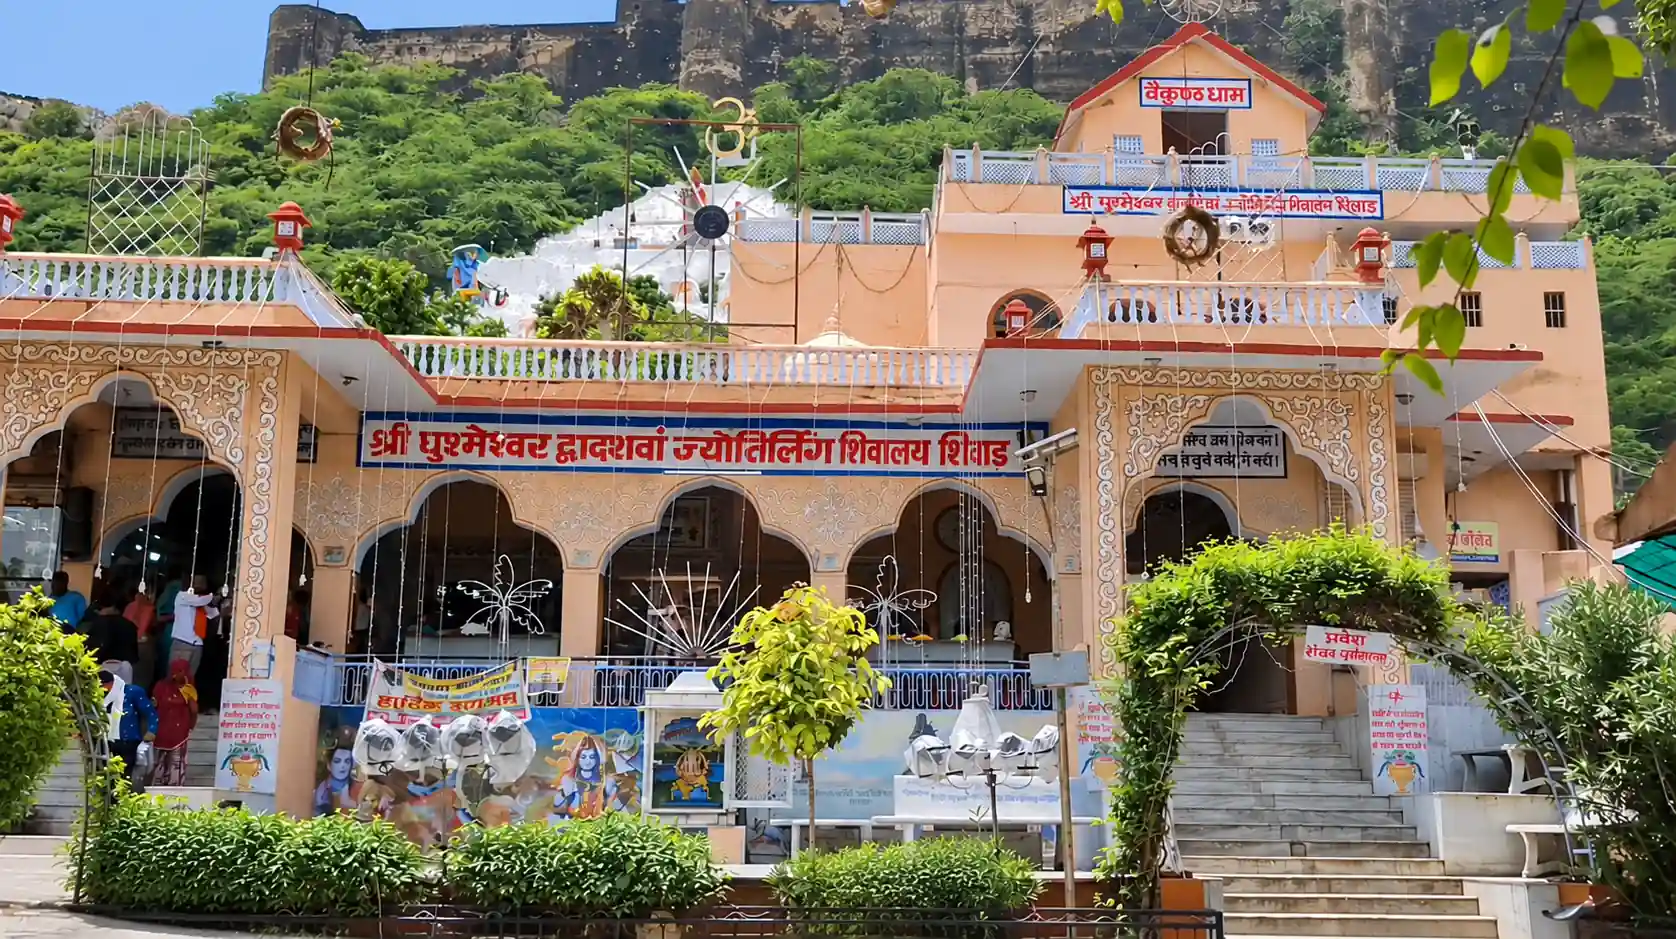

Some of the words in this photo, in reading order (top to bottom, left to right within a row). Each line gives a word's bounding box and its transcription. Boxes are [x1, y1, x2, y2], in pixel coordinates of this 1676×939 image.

[1144, 80, 1204, 106] वैकुण्ठ
[1207, 87, 1246, 103] धाम
[368, 422, 412, 457] श्री
[419, 424, 552, 463] घुश्मेश्वर
[556, 425, 669, 465] द्वादशवां
[673, 430, 836, 465] ज्योतिर्लिंग
[839, 430, 931, 466] शिवालय
[937, 431, 1011, 471] शिवाड़
